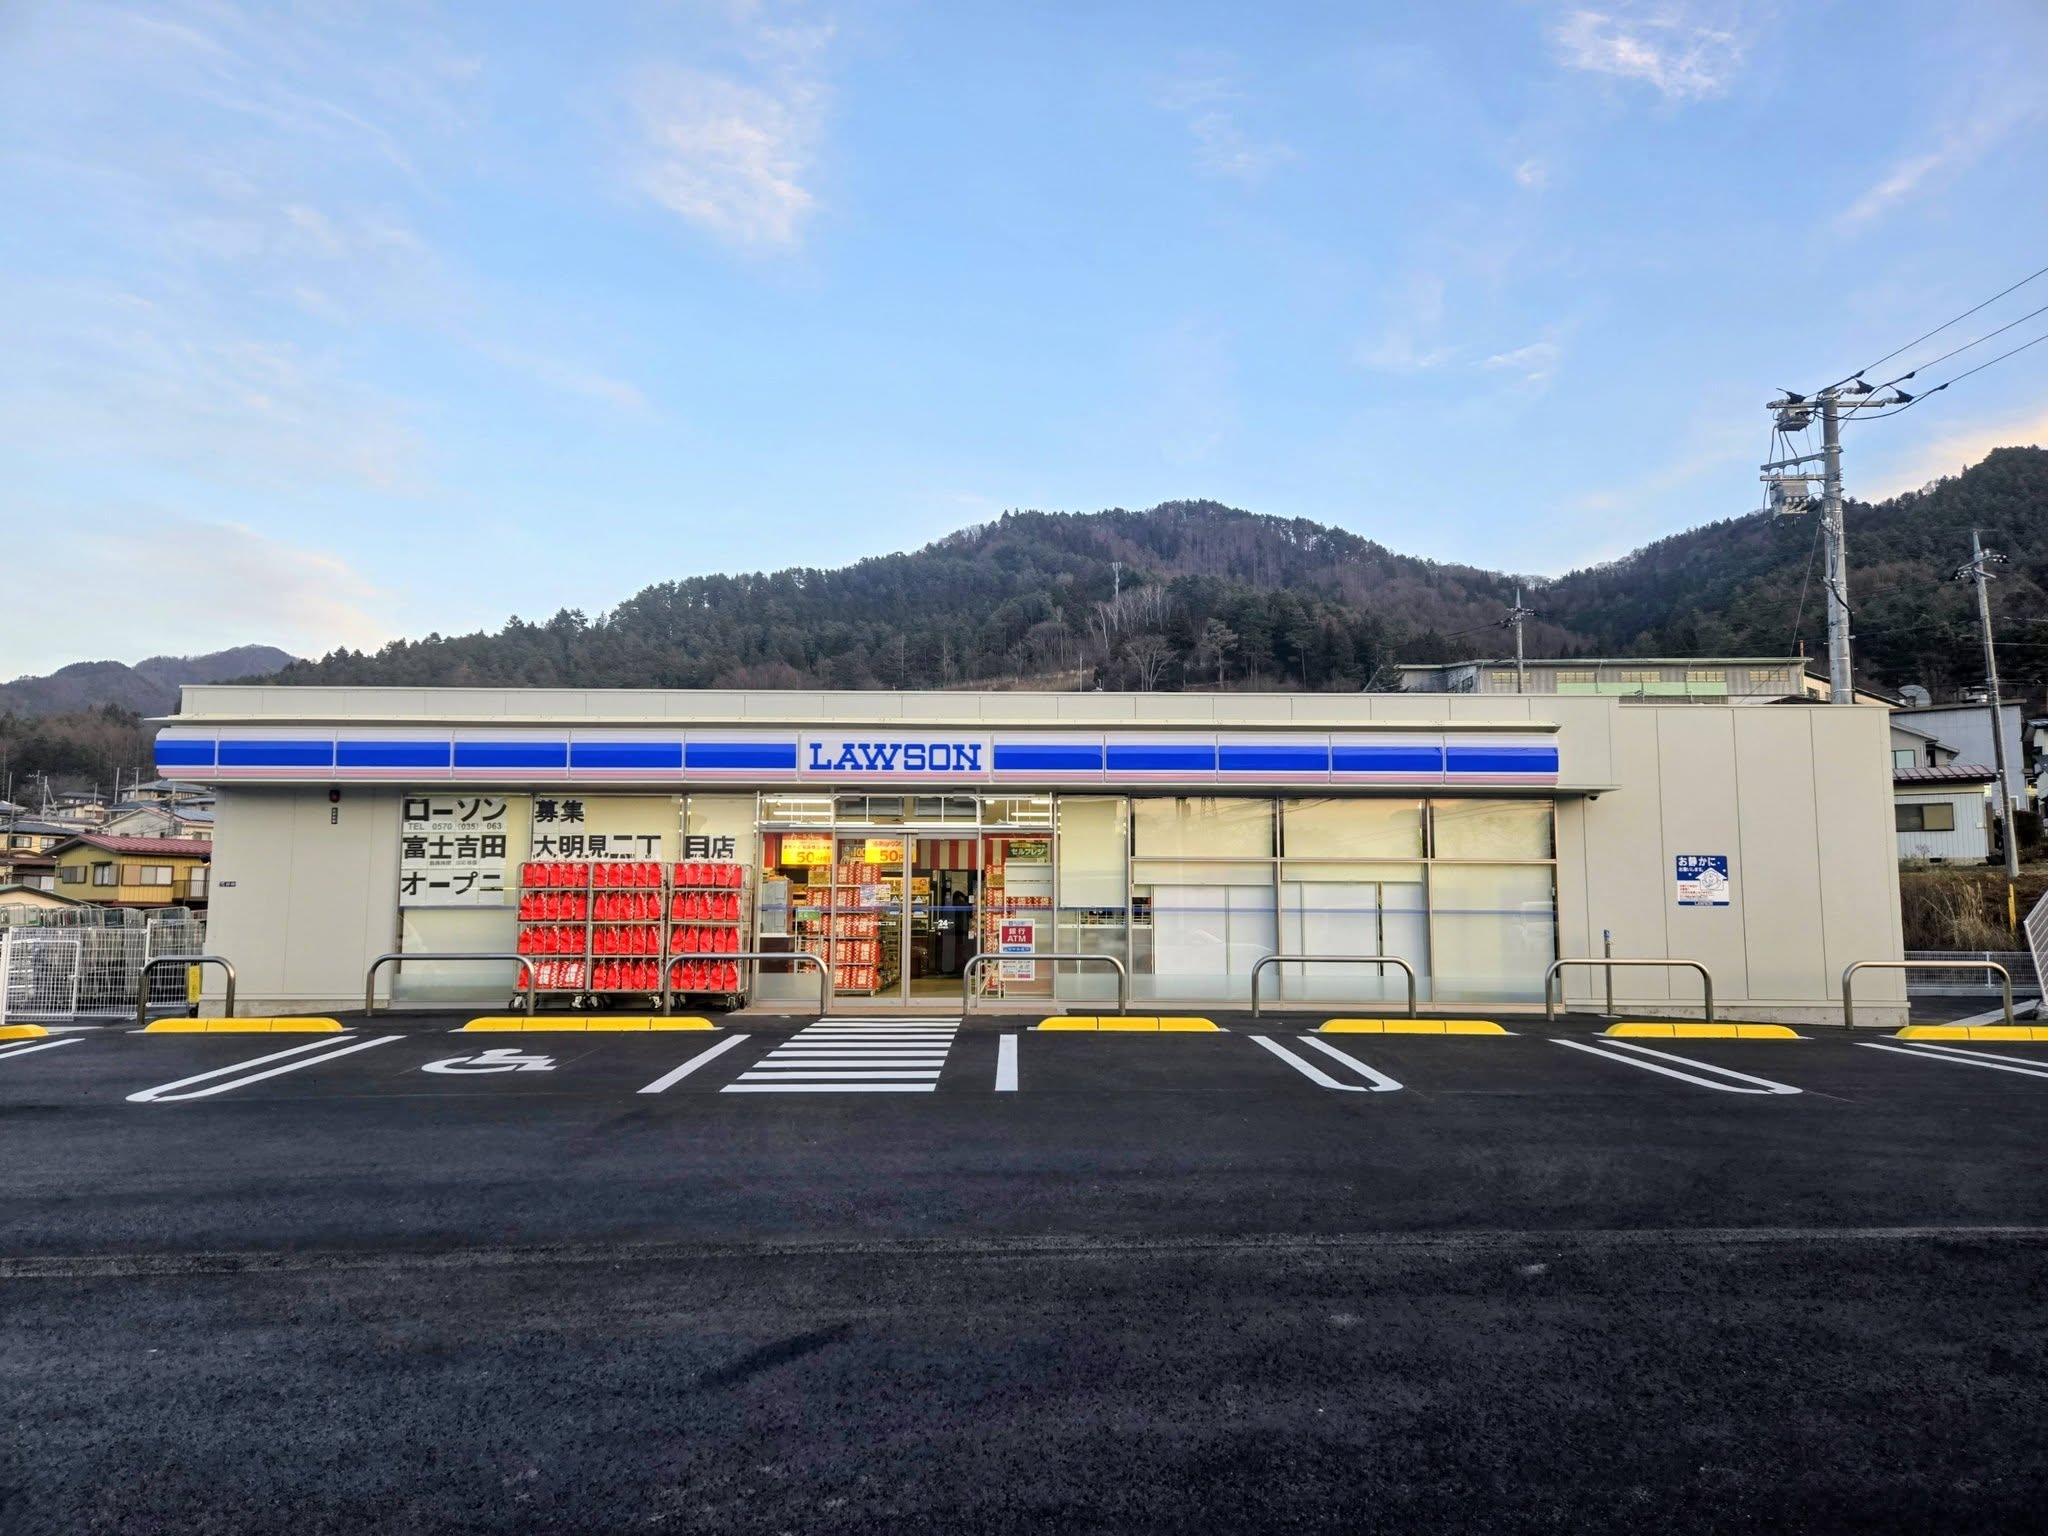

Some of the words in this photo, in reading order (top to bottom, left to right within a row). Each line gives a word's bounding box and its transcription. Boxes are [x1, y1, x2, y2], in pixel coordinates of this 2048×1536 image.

[809, 743, 981, 771] LAWSON
[404, 799, 507, 822] ローソン
[534, 800, 585, 823] 募集
[486, 822, 502, 830] 063
[403, 835, 507, 859] 富士吉田
[532, 835, 662, 859] 大明見二丁
[685, 835, 736, 859] 目店
[401, 871, 504, 895] オープニ
[1007, 935, 1026, 943] ATM
